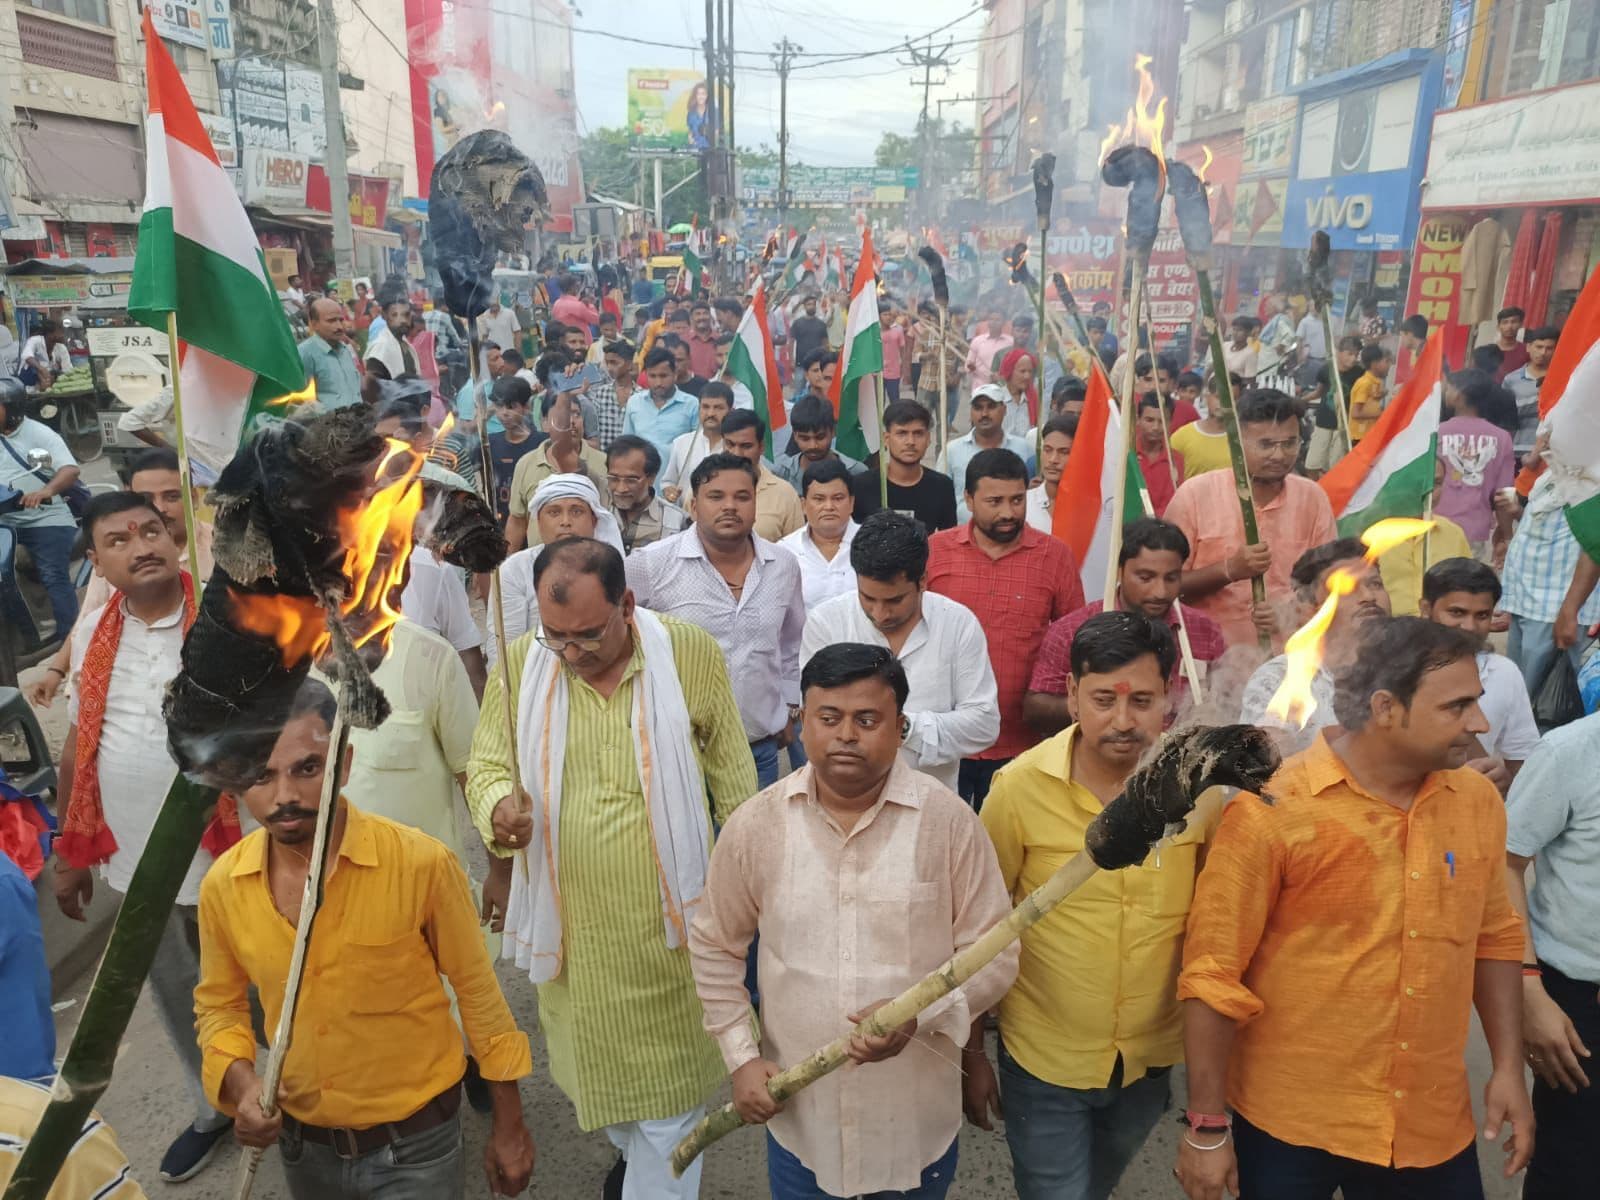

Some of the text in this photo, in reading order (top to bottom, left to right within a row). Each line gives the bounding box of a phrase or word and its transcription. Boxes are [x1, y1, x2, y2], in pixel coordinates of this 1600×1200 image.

[266, 156, 304, 184] HERO
[1046, 226, 1116, 259] गणेश
[1423, 222, 1466, 242] NEW
